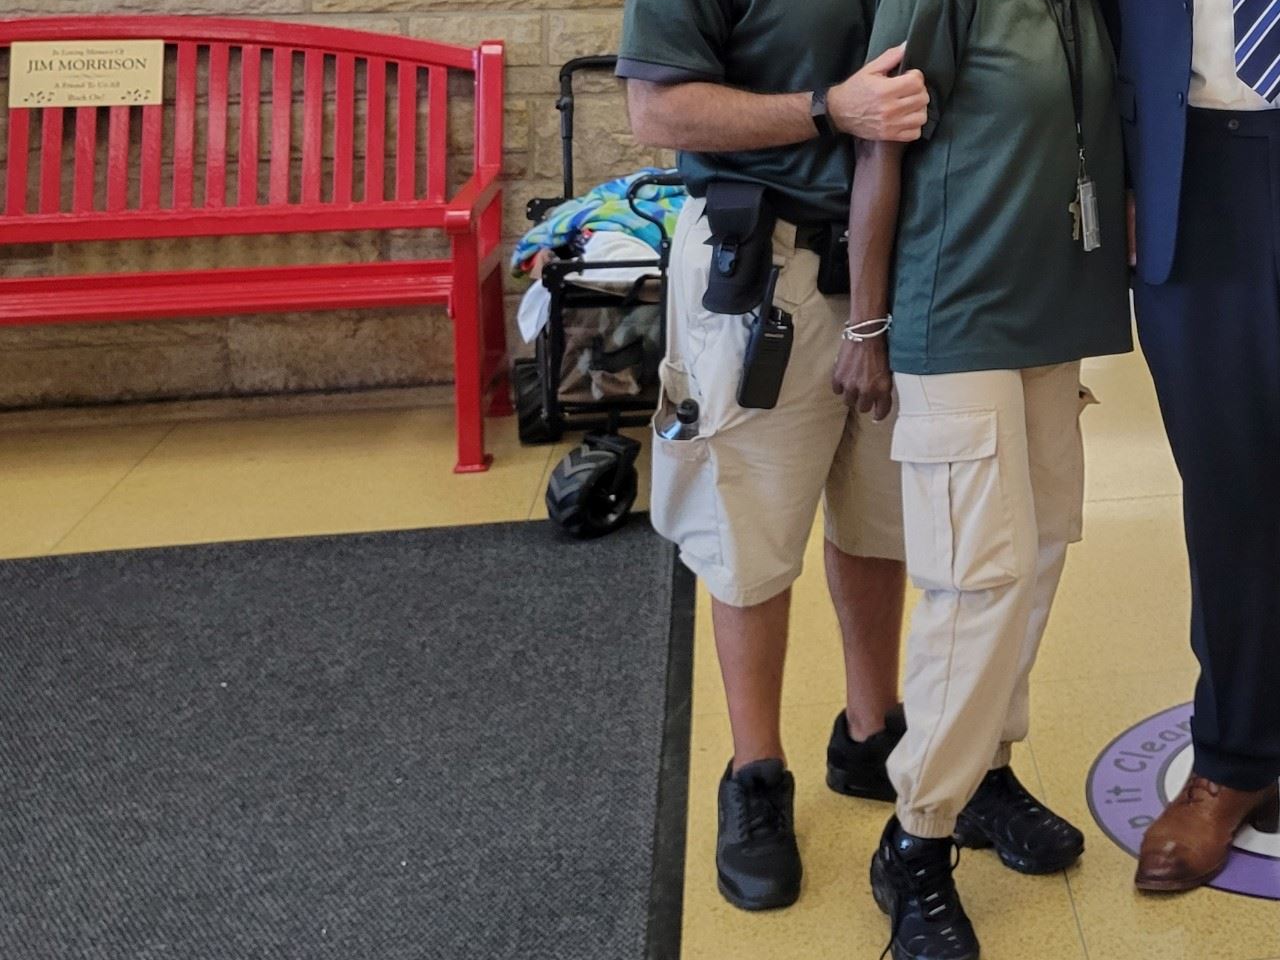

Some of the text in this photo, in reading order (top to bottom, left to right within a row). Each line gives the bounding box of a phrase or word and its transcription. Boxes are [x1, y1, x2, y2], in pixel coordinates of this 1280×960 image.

[27, 58, 148, 74] JIM MORRISON
[1104, 785, 1142, 804] it
